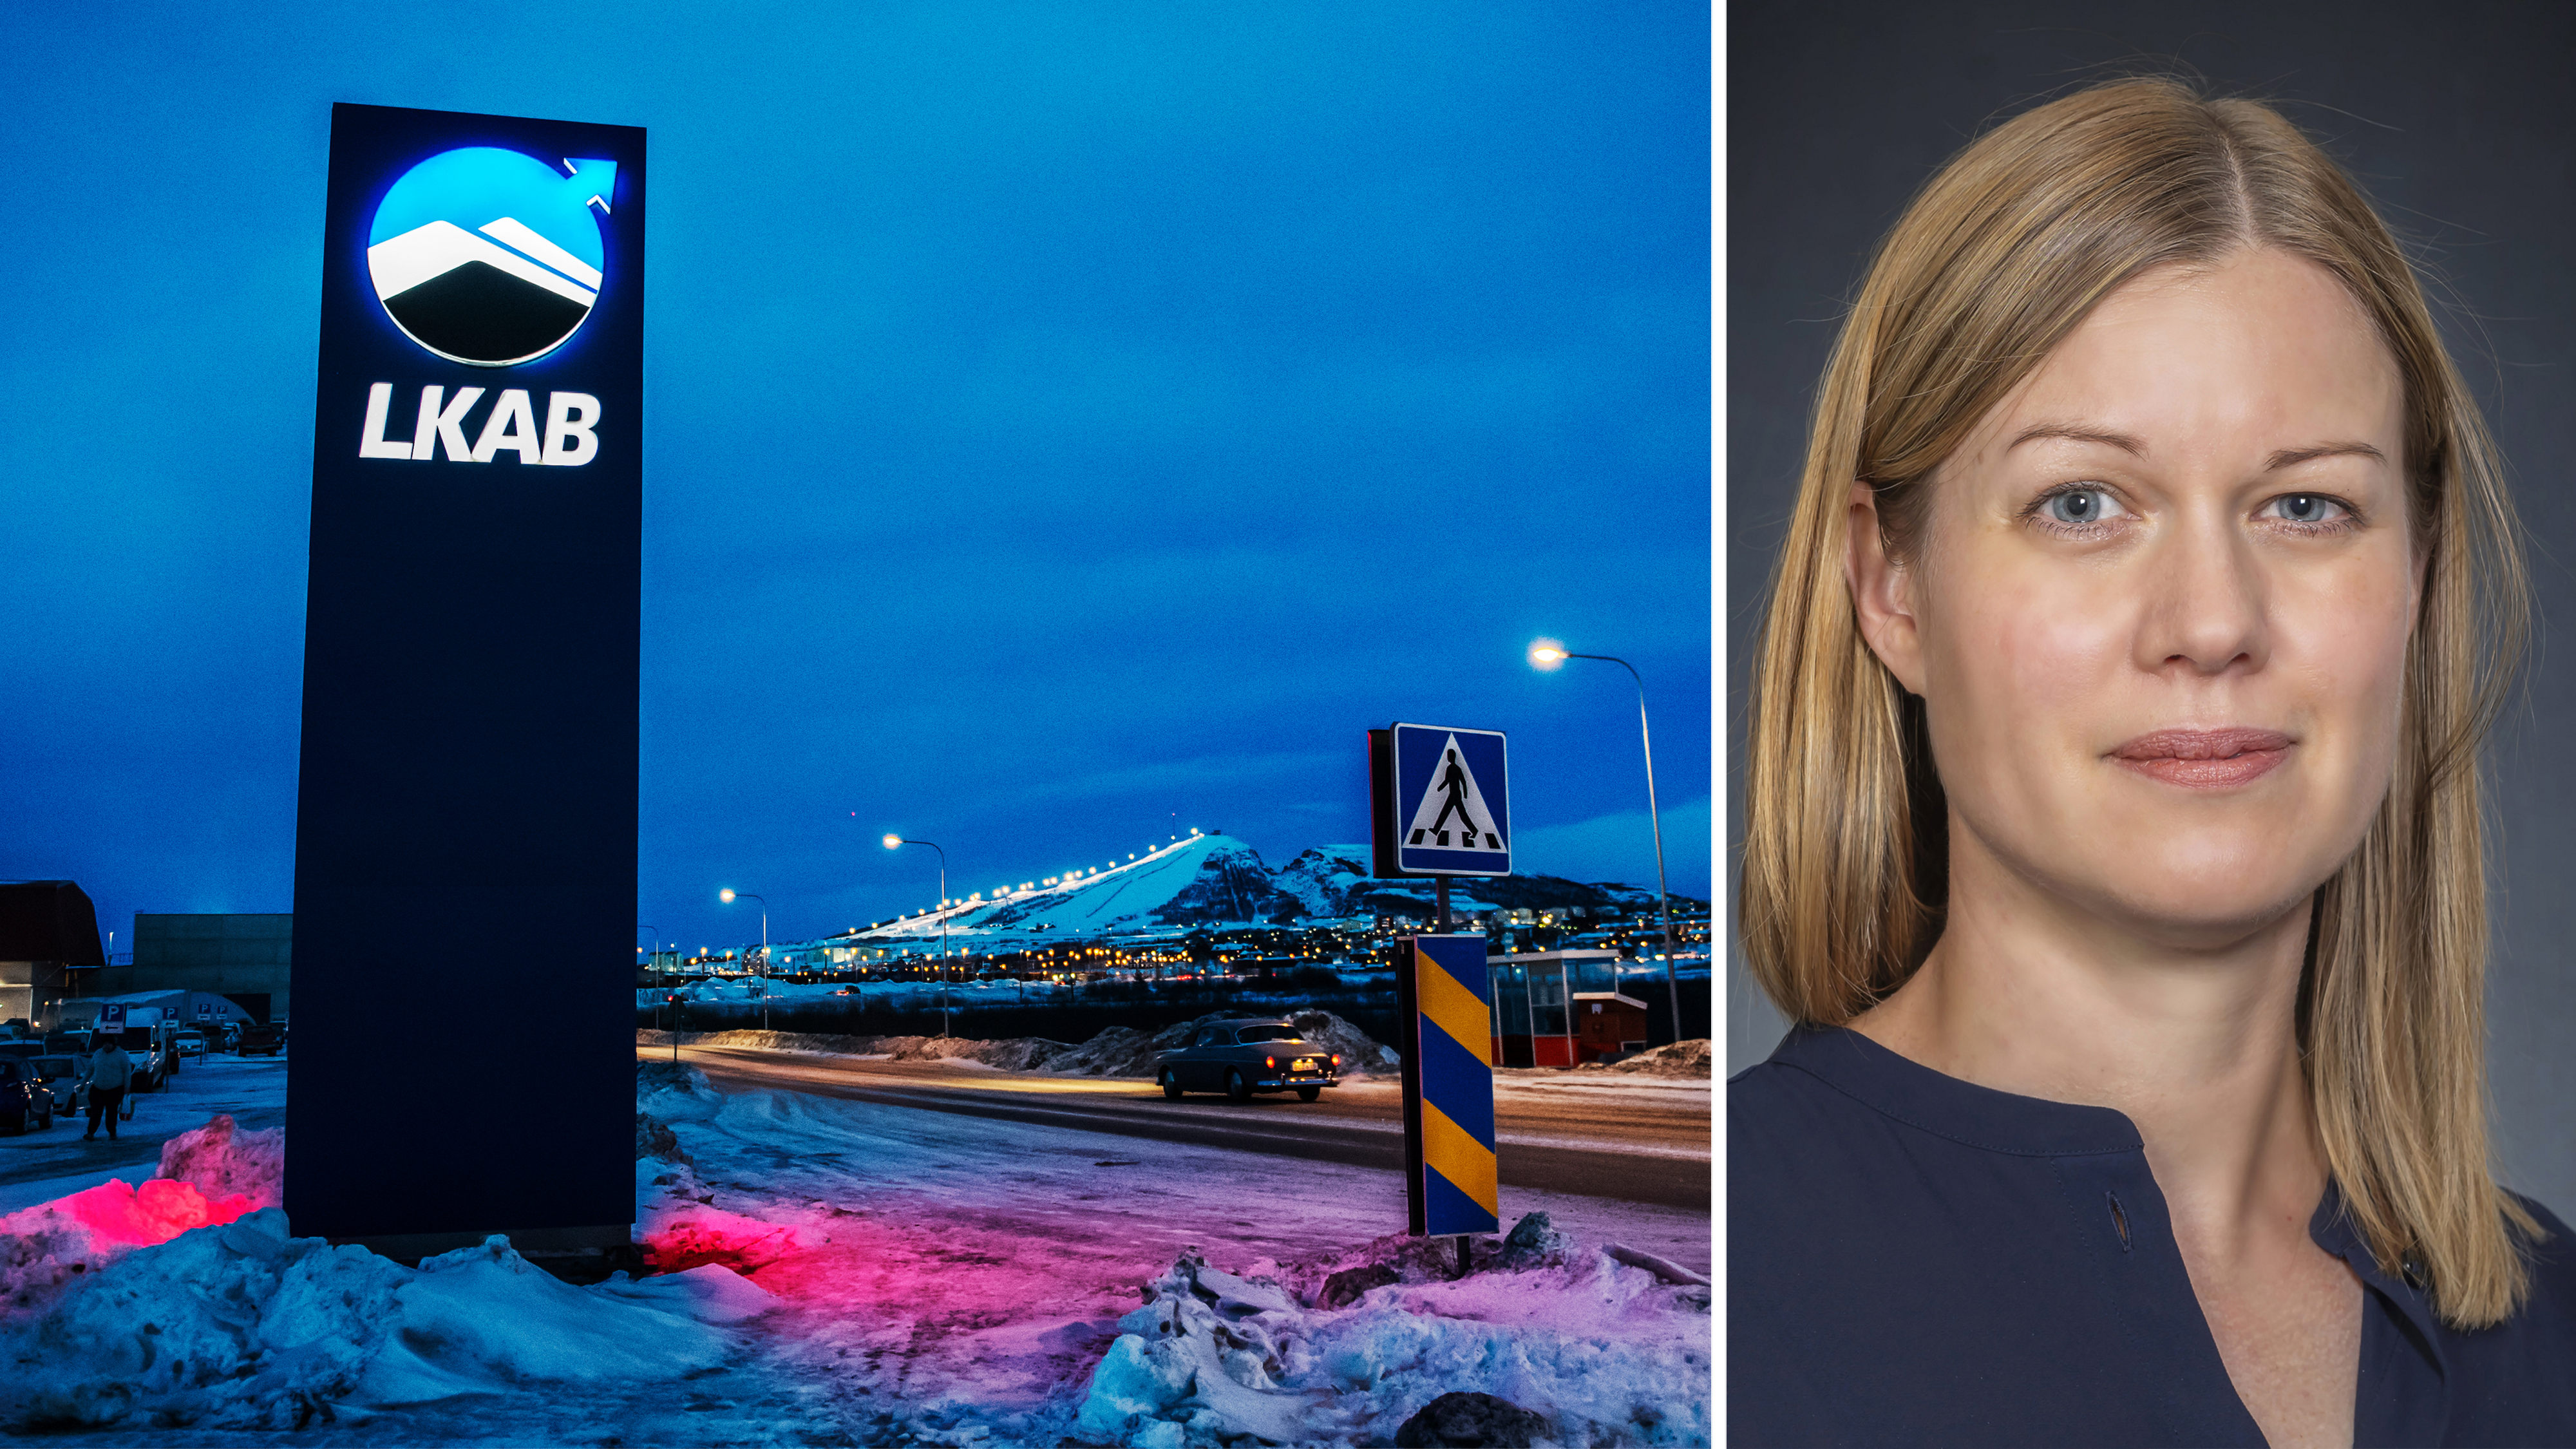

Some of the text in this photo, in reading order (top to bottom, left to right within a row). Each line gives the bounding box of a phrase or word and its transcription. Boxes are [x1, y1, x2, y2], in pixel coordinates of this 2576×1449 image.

[359, 383, 601, 466] LKAB
[108, 1005, 119, 1021] P
[167, 1008, 175, 1019] P
[202, 1004, 208, 1012] P
